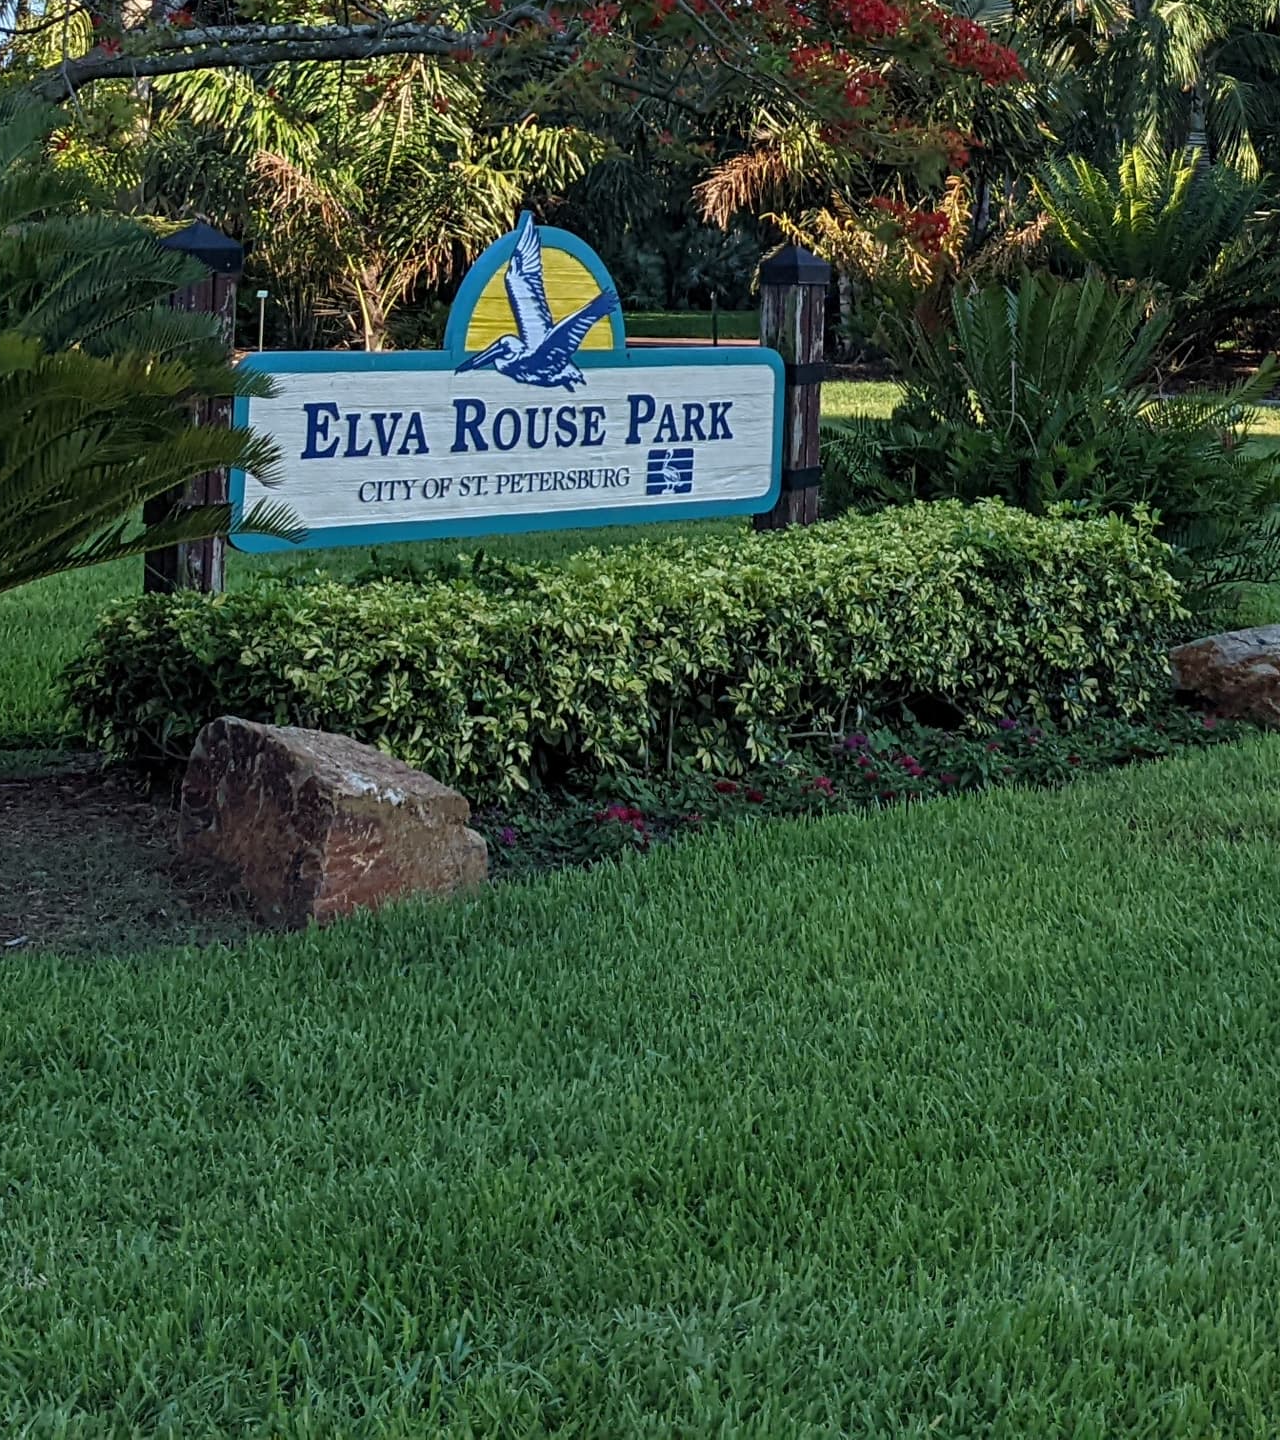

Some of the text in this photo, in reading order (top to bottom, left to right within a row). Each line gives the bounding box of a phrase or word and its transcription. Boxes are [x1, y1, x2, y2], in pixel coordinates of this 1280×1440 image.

[300, 393, 734, 460] ELVA ROUSE PARK
[358, 466, 631, 503] CITY OF ST. PETERSBURG
